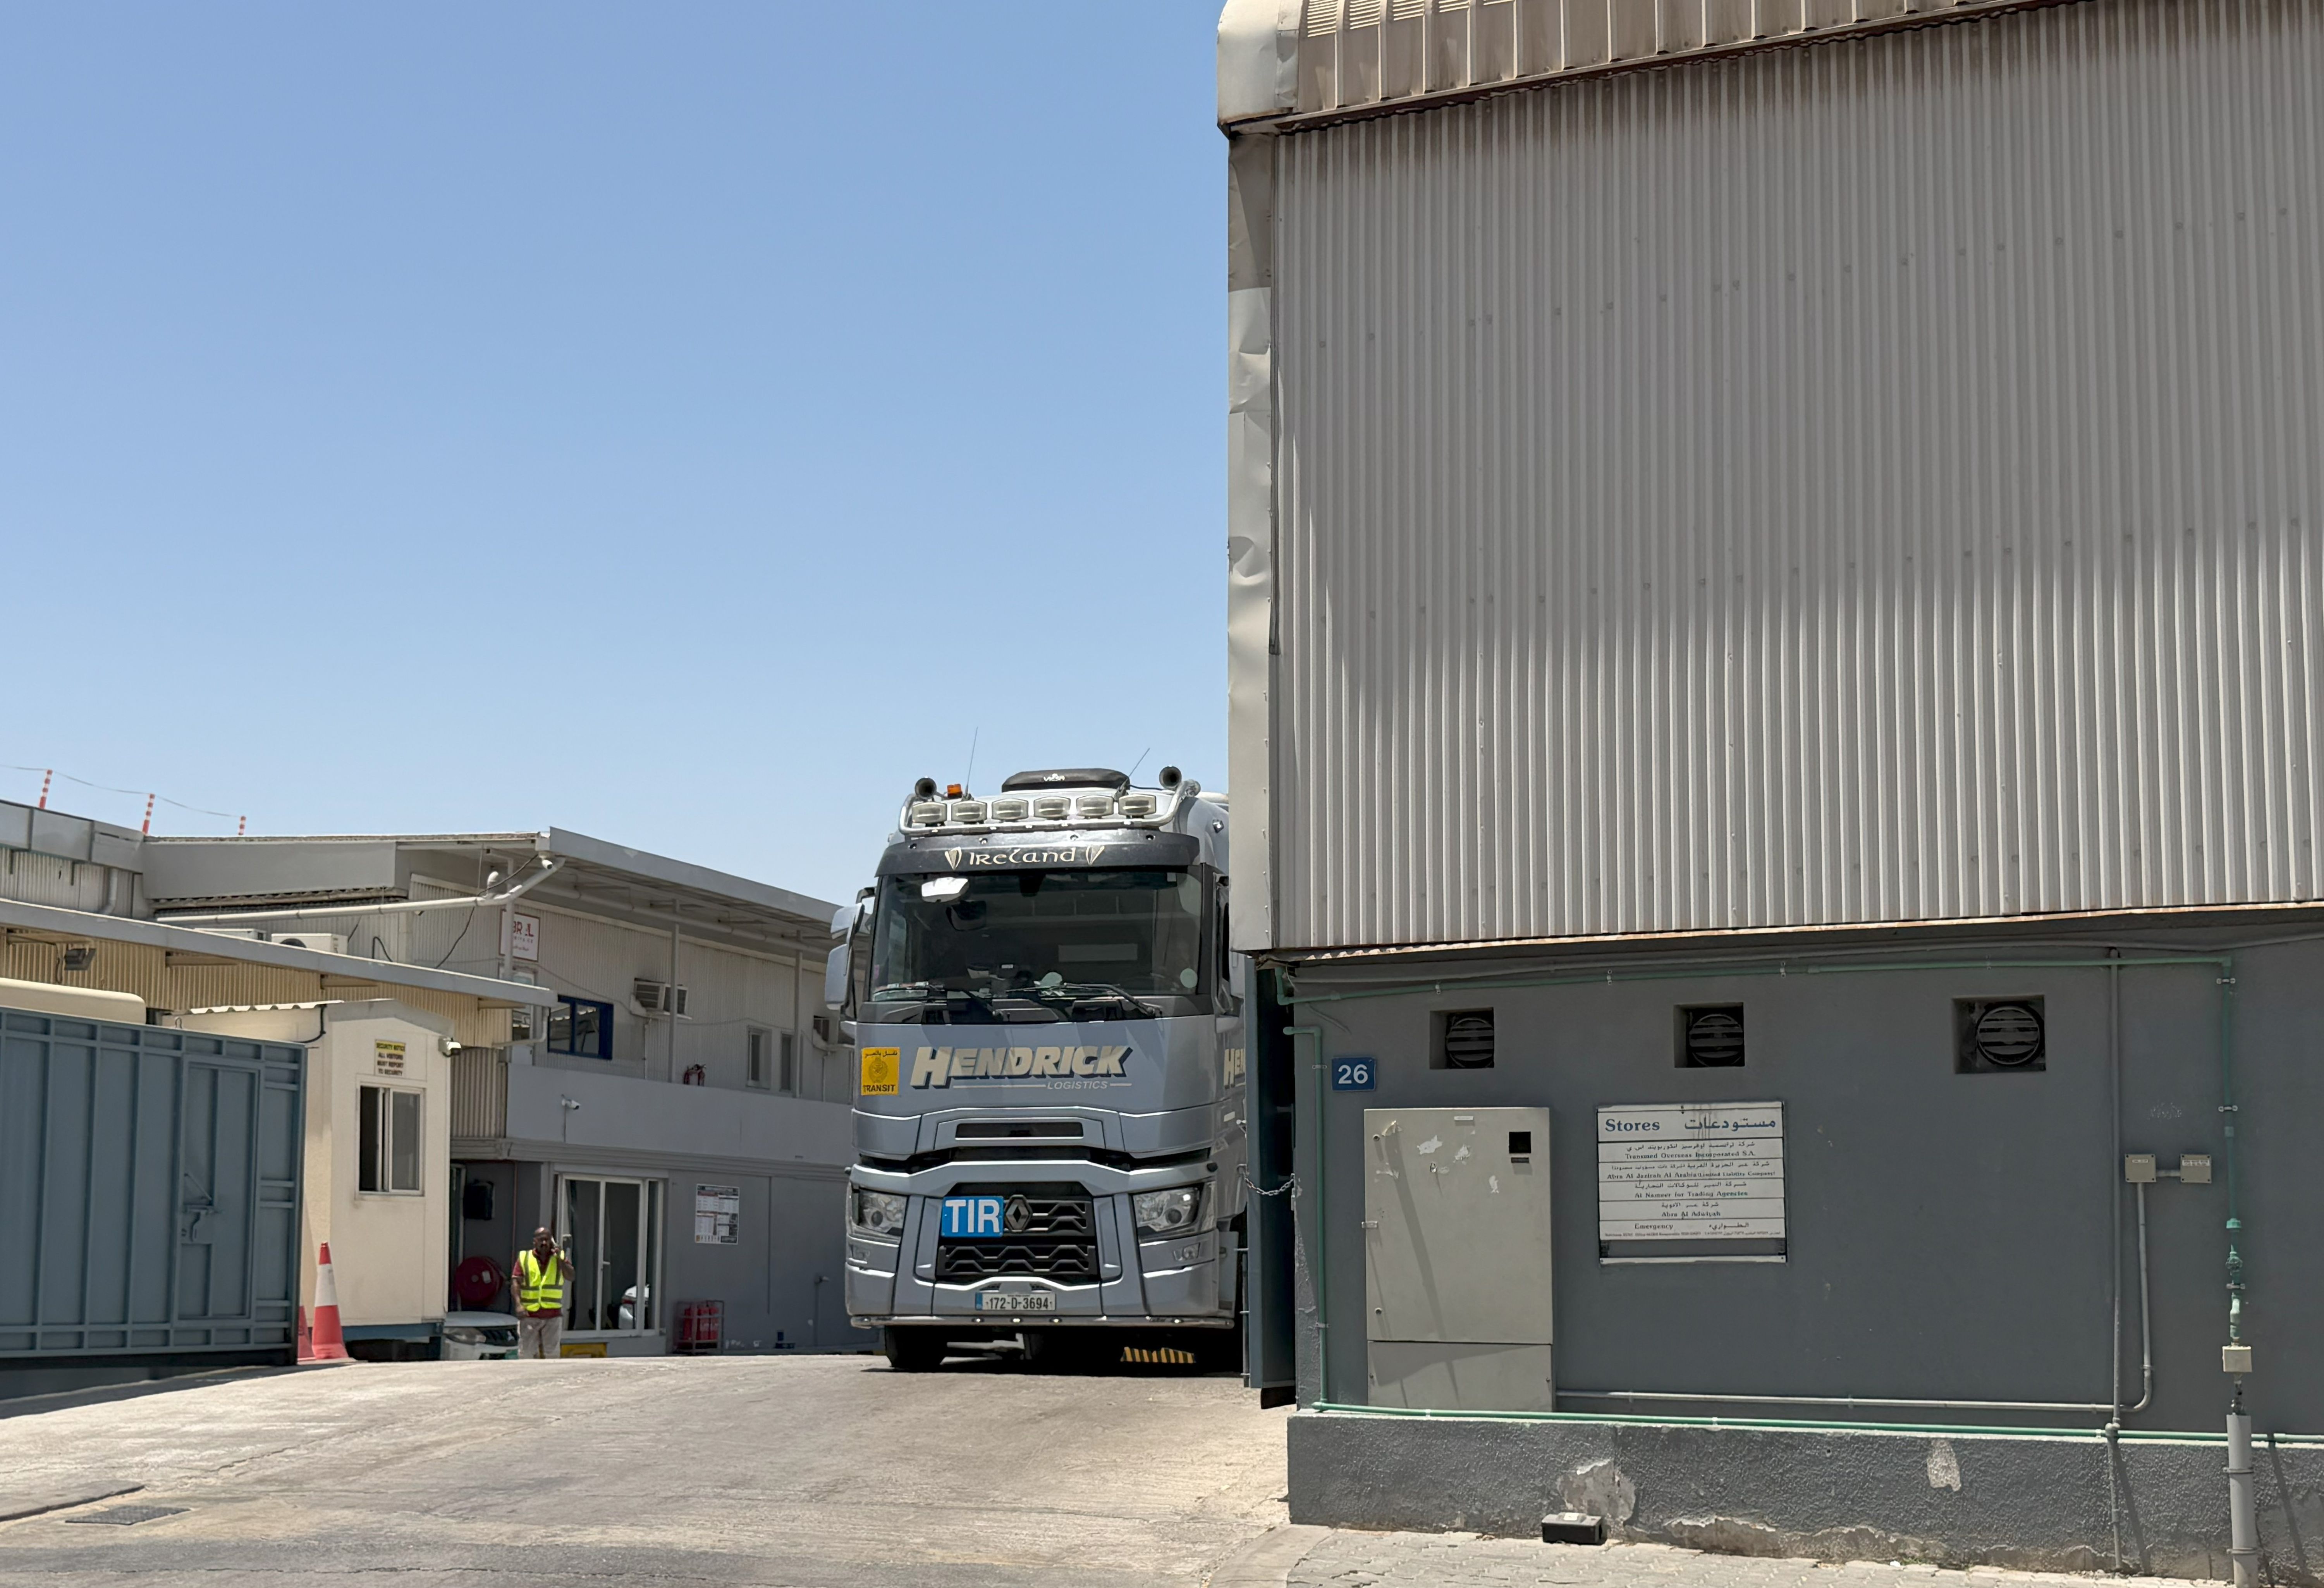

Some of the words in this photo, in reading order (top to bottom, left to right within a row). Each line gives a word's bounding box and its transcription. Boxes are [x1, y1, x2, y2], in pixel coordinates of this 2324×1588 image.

[910, 1046, 1133, 1090] HENDRICK
[1338, 1064, 1368, 1084] 26
[1047, 1081, 1108, 1090] LOGISTICS
[1605, 1119, 1660, 1132] Stores
[1685, 1116, 1776, 1132] مستودعات
[945, 1200, 1000, 1232] TIR
[989, 1298, 1049, 1309] 172-D-3694
